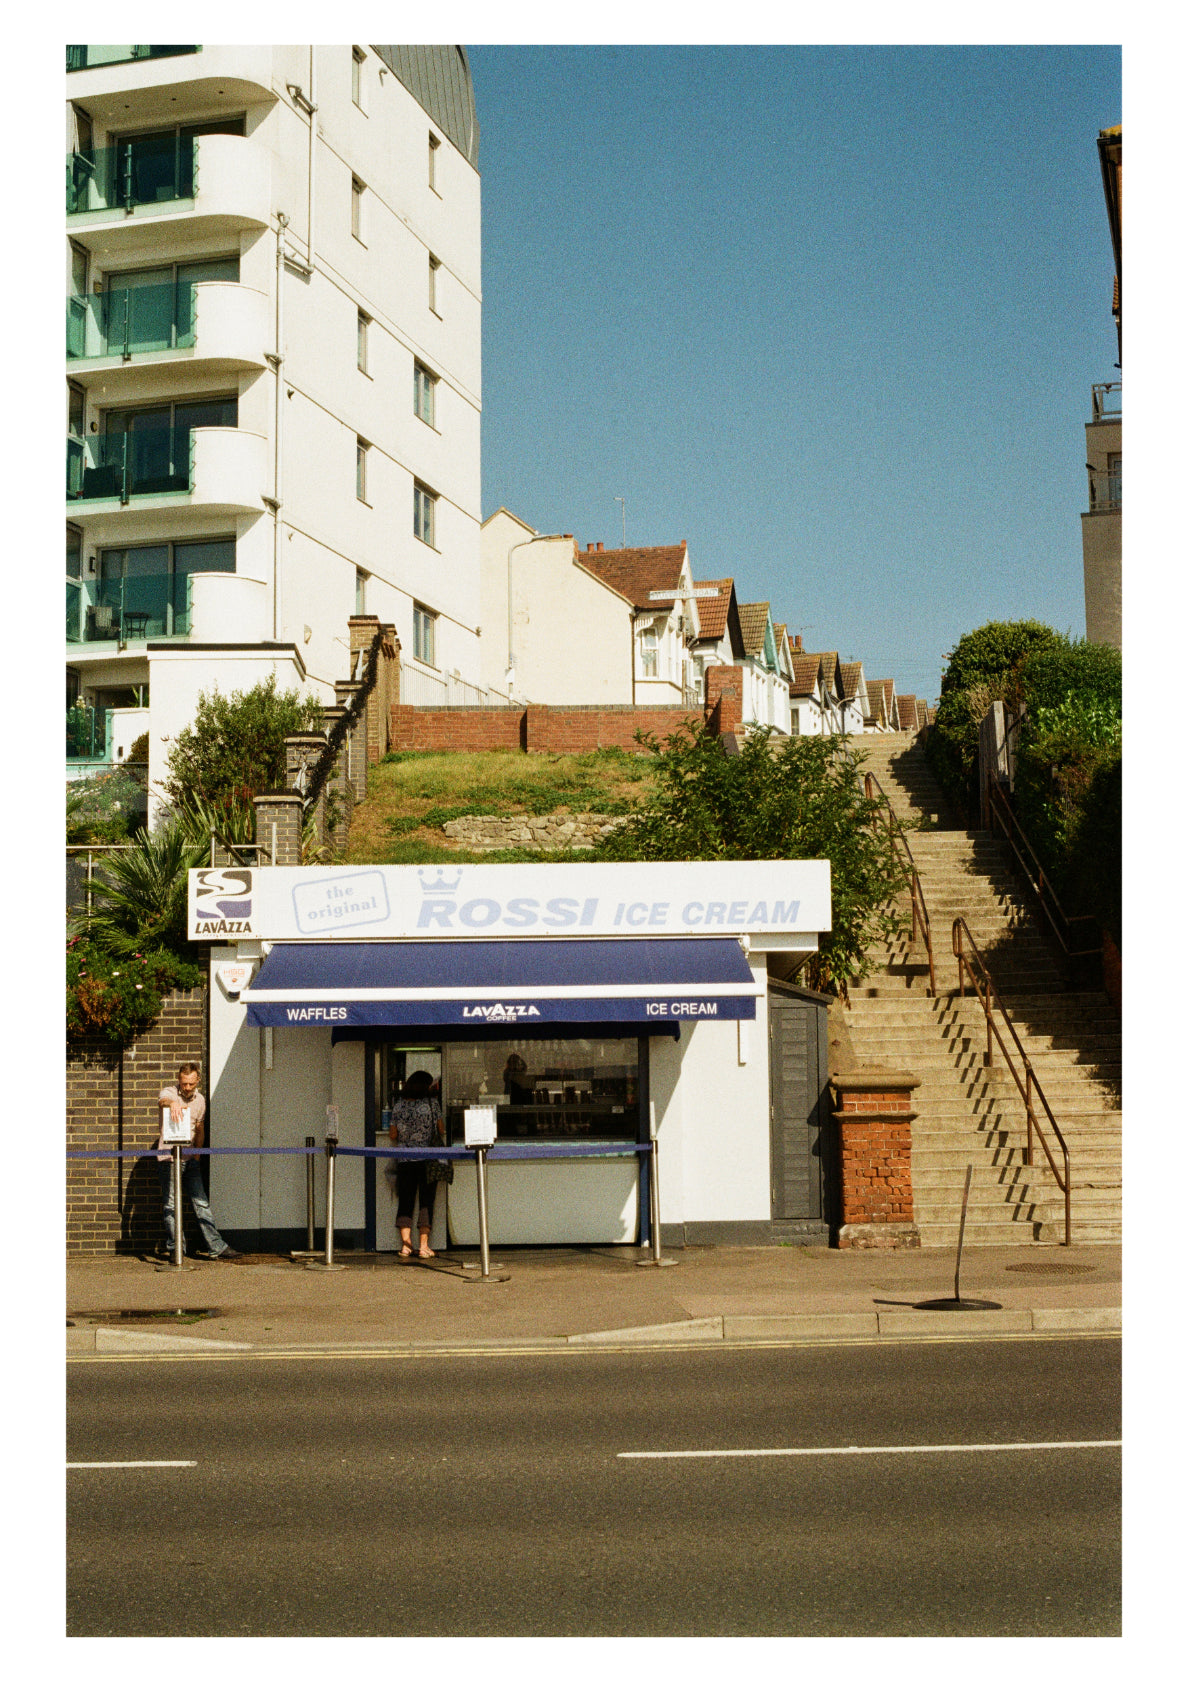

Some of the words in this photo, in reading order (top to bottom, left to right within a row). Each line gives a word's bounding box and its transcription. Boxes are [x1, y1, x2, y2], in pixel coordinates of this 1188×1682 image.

[693, 589, 715, 597] ROAD
[326, 885, 354, 901] the
[307, 896, 377, 920] original
[416, 897, 599, 929] ROSSI
[613, 902, 671, 928] ICE
[681, 900, 801, 928] CREAM
[195, 919, 252, 934] LAVAZZA
[286, 1007, 348, 1021] WAFFLES
[462, 1003, 541, 1018] LAVAZZA
[646, 1003, 668, 1016] ICE
[670, 1002, 718, 1016] CREAM
[485, 1014, 518, 1022] COFFEE
